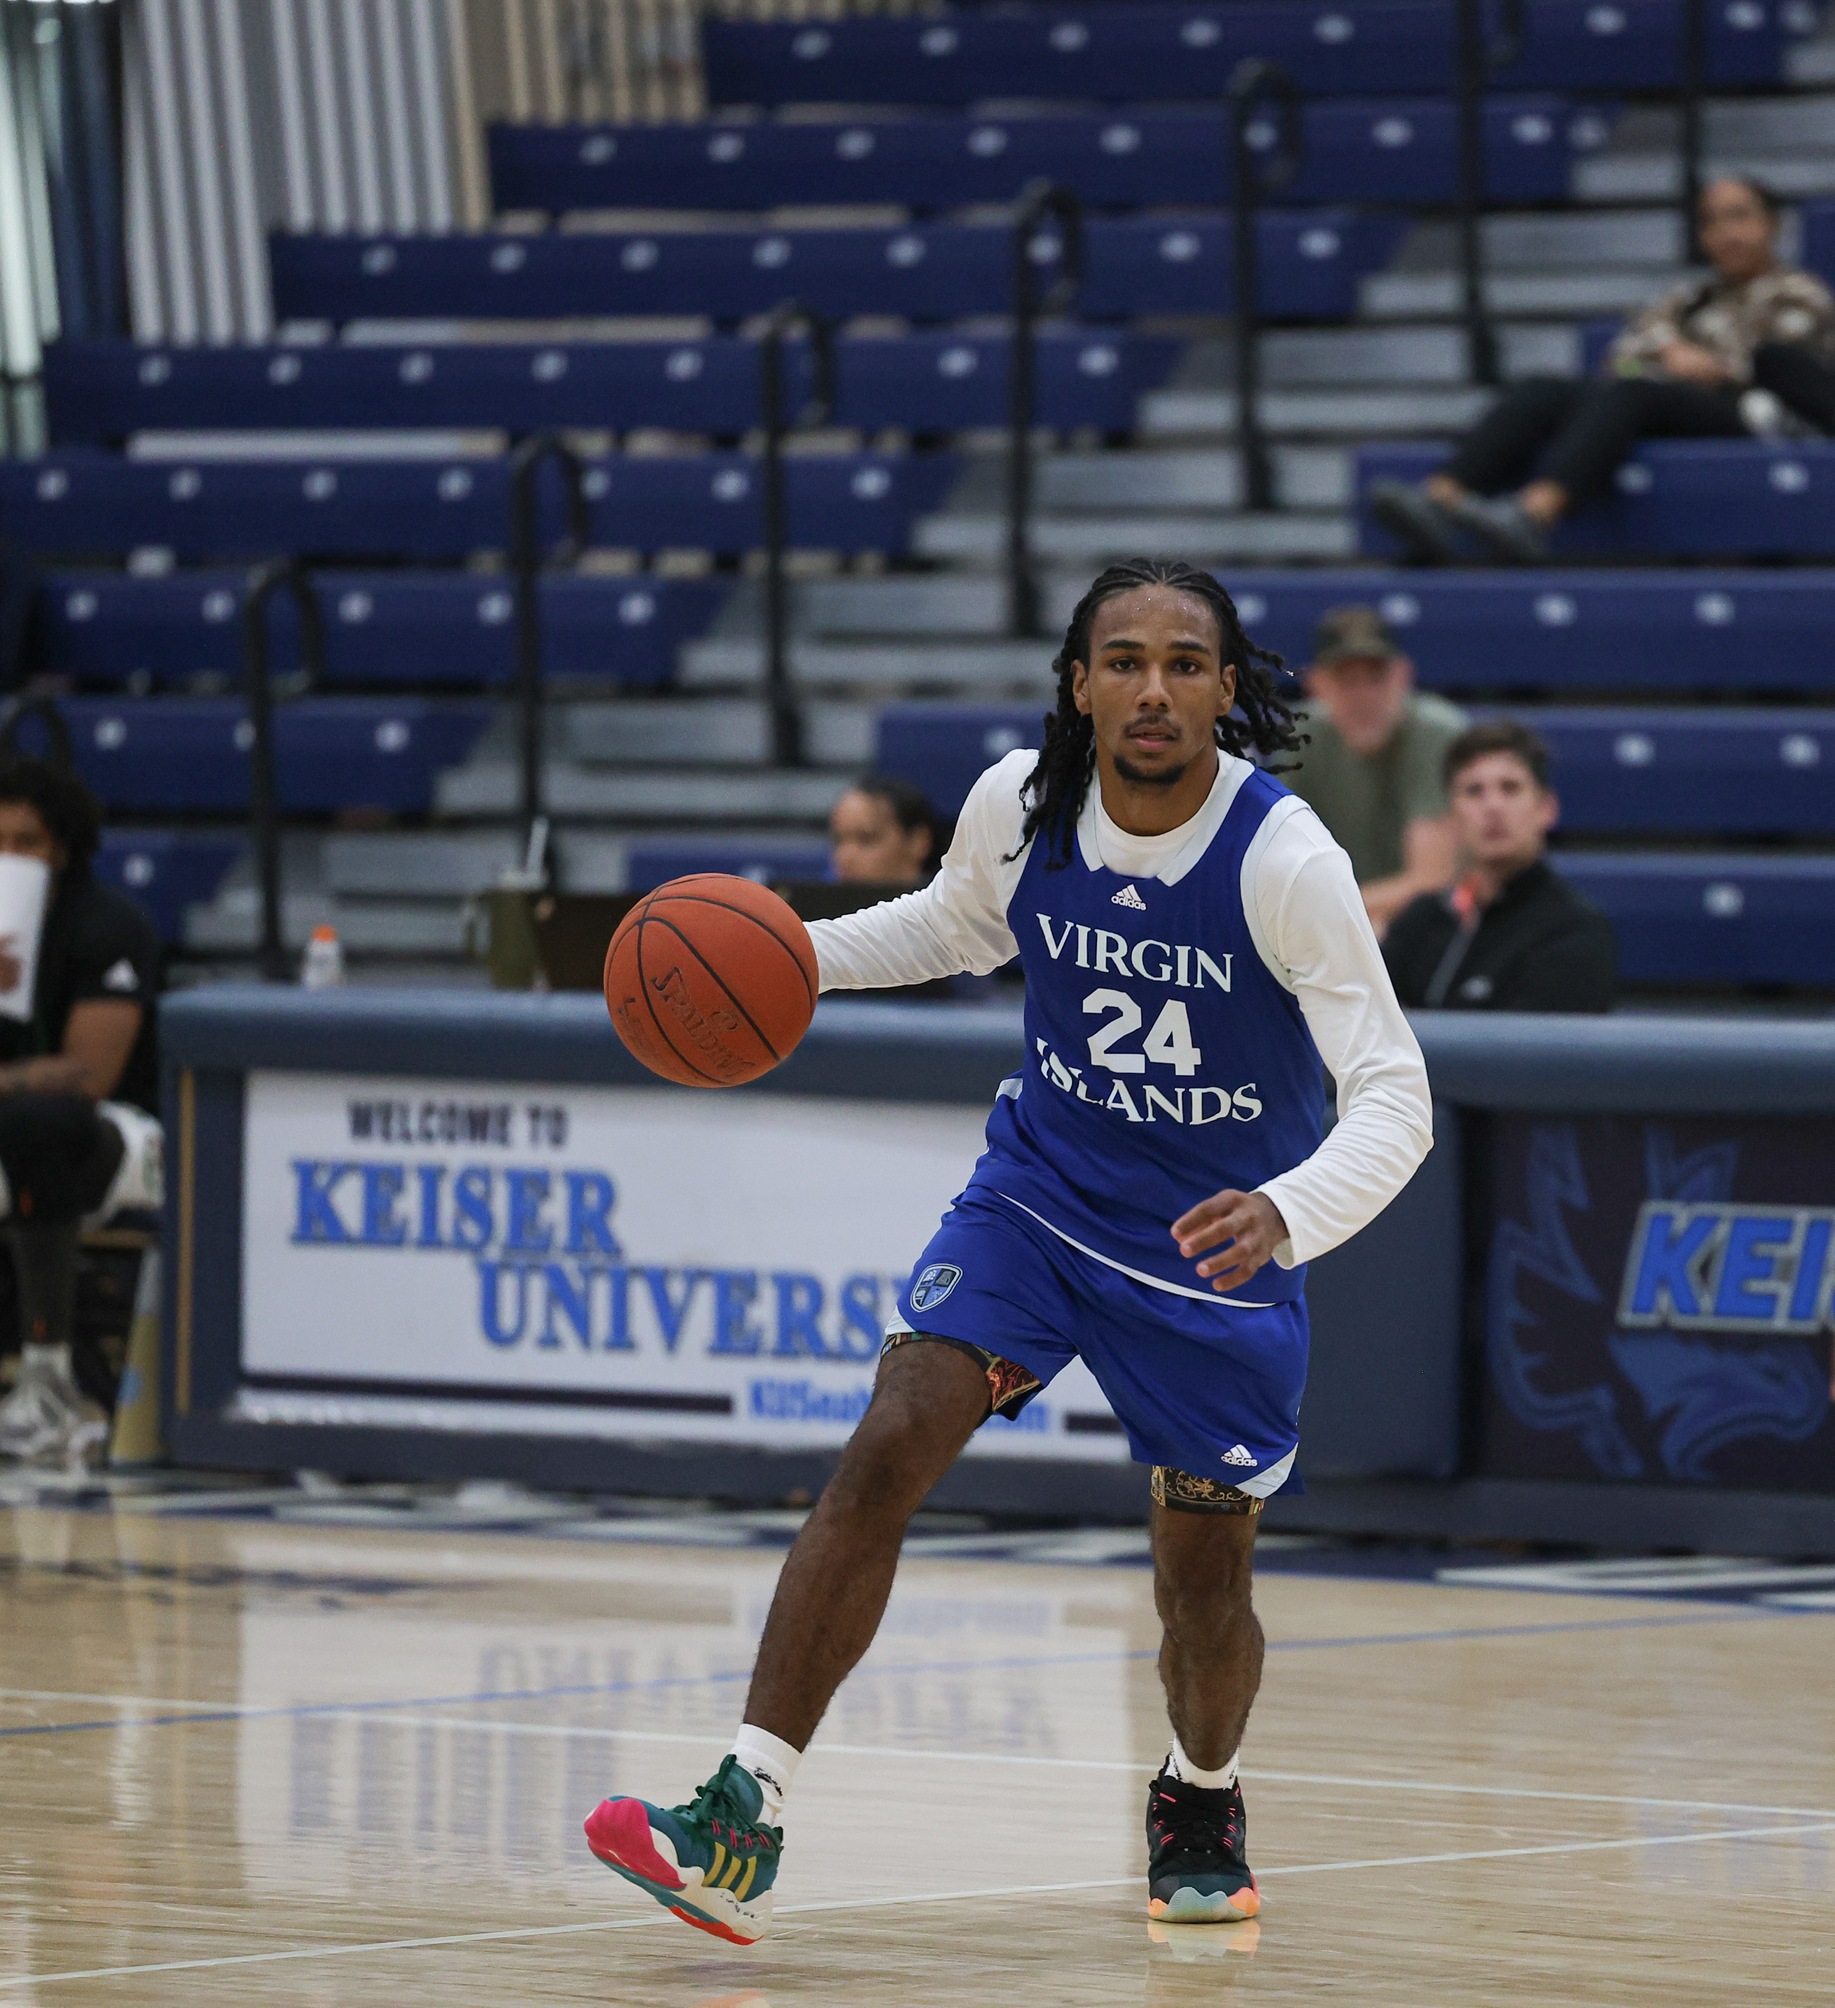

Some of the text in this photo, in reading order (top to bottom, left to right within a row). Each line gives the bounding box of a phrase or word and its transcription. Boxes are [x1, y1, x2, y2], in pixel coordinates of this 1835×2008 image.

[1111, 895, 1147, 911] adidas
[1036, 913, 1233, 992] VIRGIN
[1082, 988, 1201, 1076] 24
[1036, 1037, 1262, 1126] ISLANDS
[348, 1100, 568, 1150] WELCOME TO
[291, 1159, 624, 1255] KEISER
[1616, 1200, 1835, 1334] KEI
[1221, 1454, 1258, 1467] adidas
